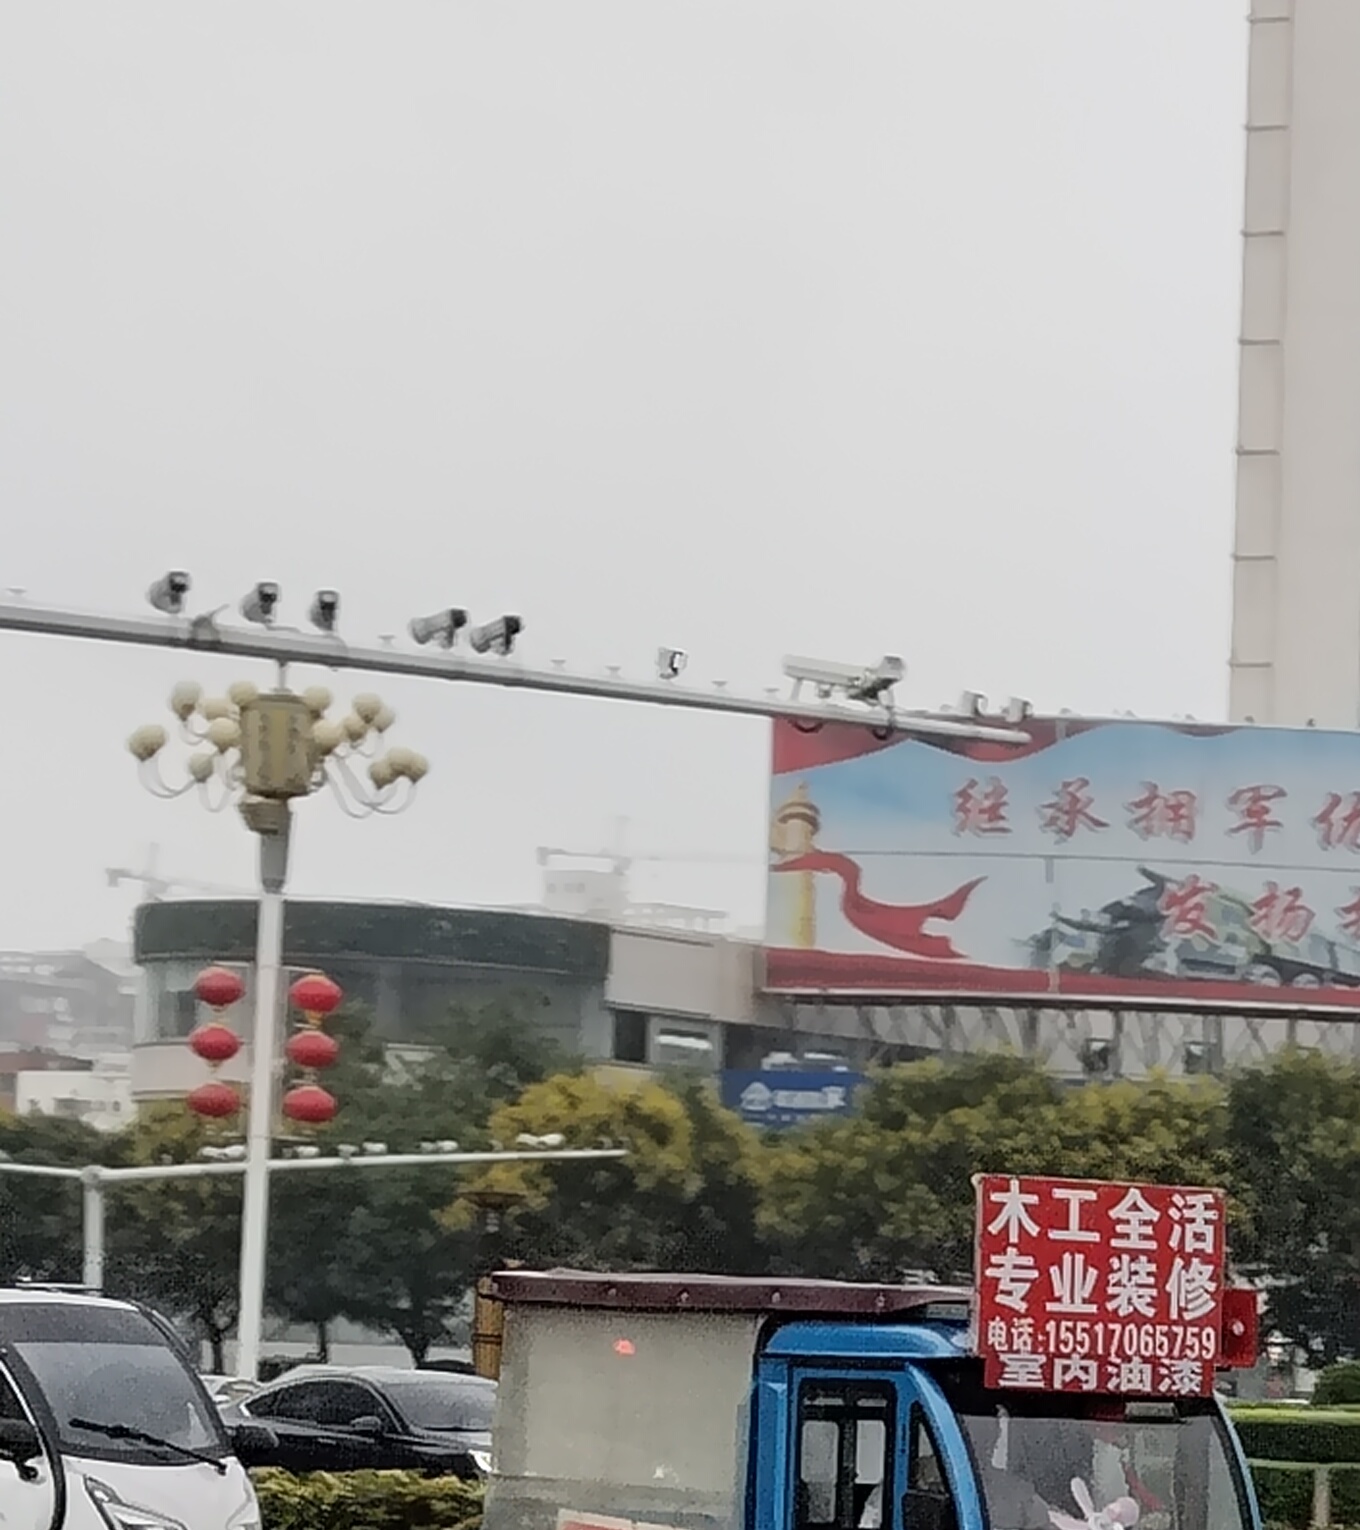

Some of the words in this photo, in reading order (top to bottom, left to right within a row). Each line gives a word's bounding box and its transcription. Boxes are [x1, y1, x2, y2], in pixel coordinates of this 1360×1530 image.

[987, 1180, 1219, 1254] 木工全活
[985, 1246, 1217, 1321] 专业装修
[998, 1352, 1203, 1396] 室内油漆
